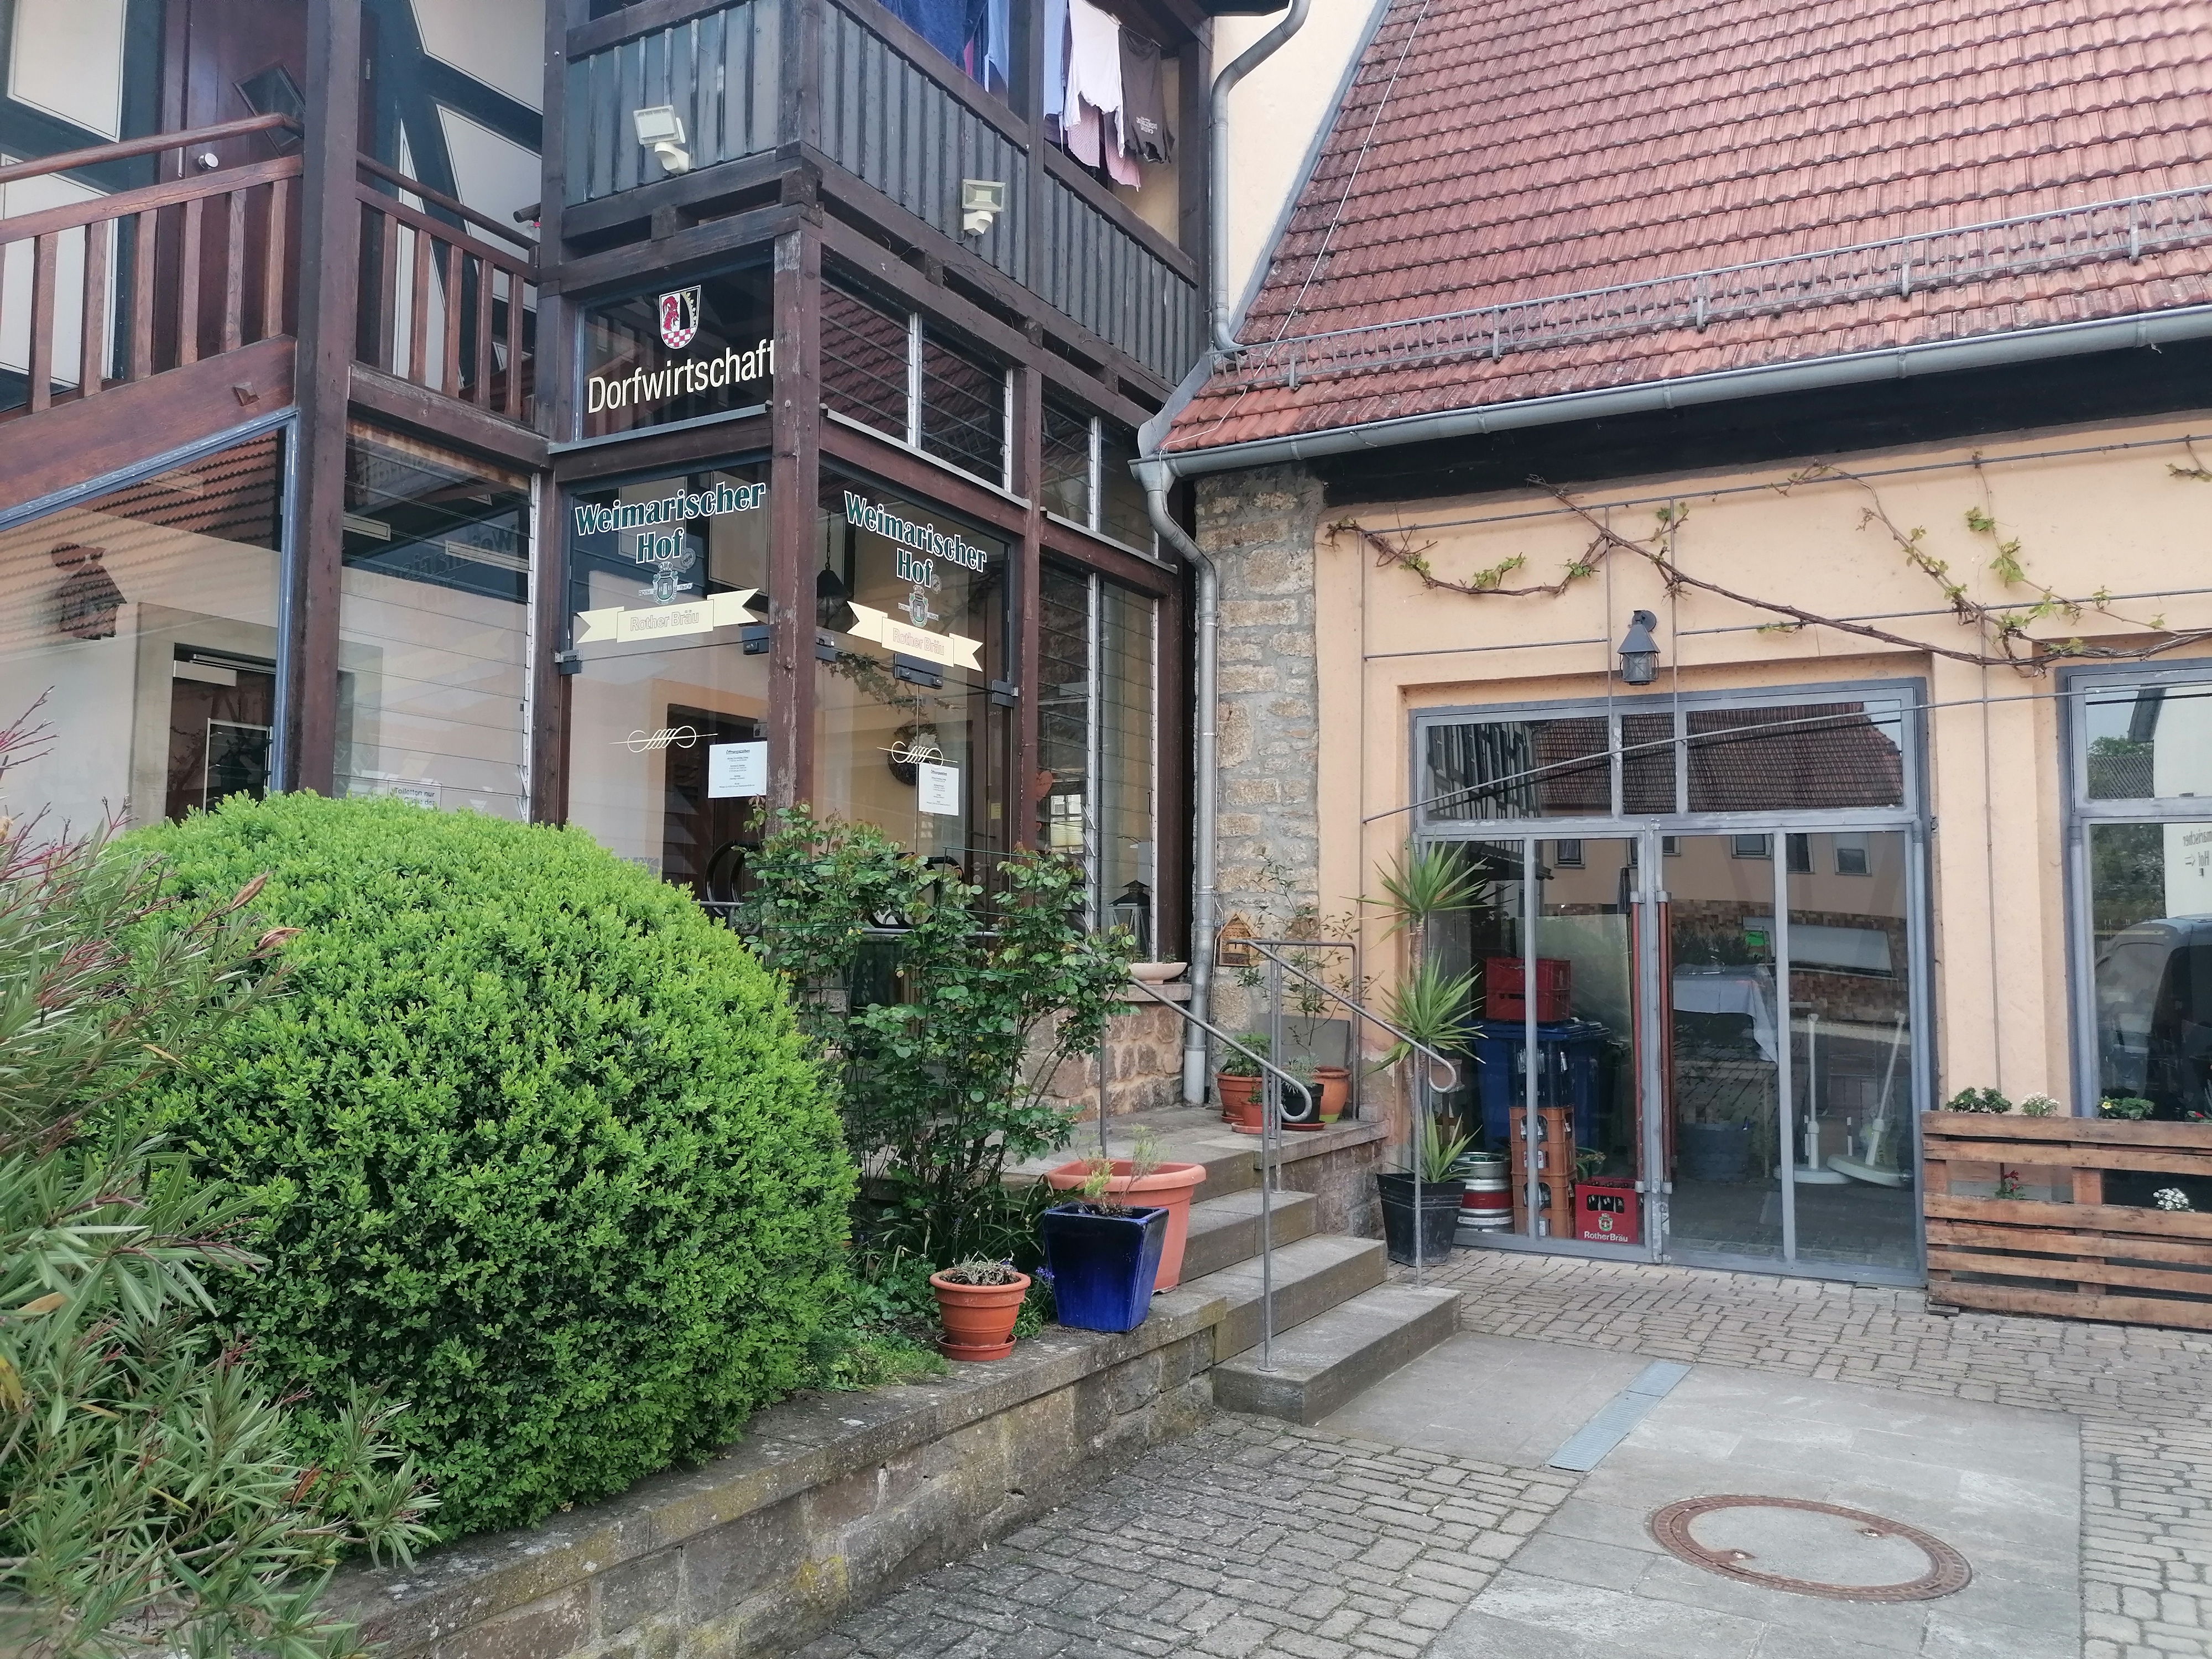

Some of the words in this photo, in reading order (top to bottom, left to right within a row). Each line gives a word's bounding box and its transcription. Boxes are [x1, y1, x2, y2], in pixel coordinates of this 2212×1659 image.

[588, 338, 774, 414] Dorfwirtschaft
[575, 481, 766, 536] Weimarischer
[635, 527, 685, 564] Hof
[844, 490, 987, 573] Weimarischer
[896, 547, 933, 588] Hof
[630, 614, 670, 632] Rother
[671, 609, 699, 627] Bräu
[893, 628, 924, 649] Rother
[925, 637, 945, 655] Bräu
[394, 787, 422, 796] Toiletten
